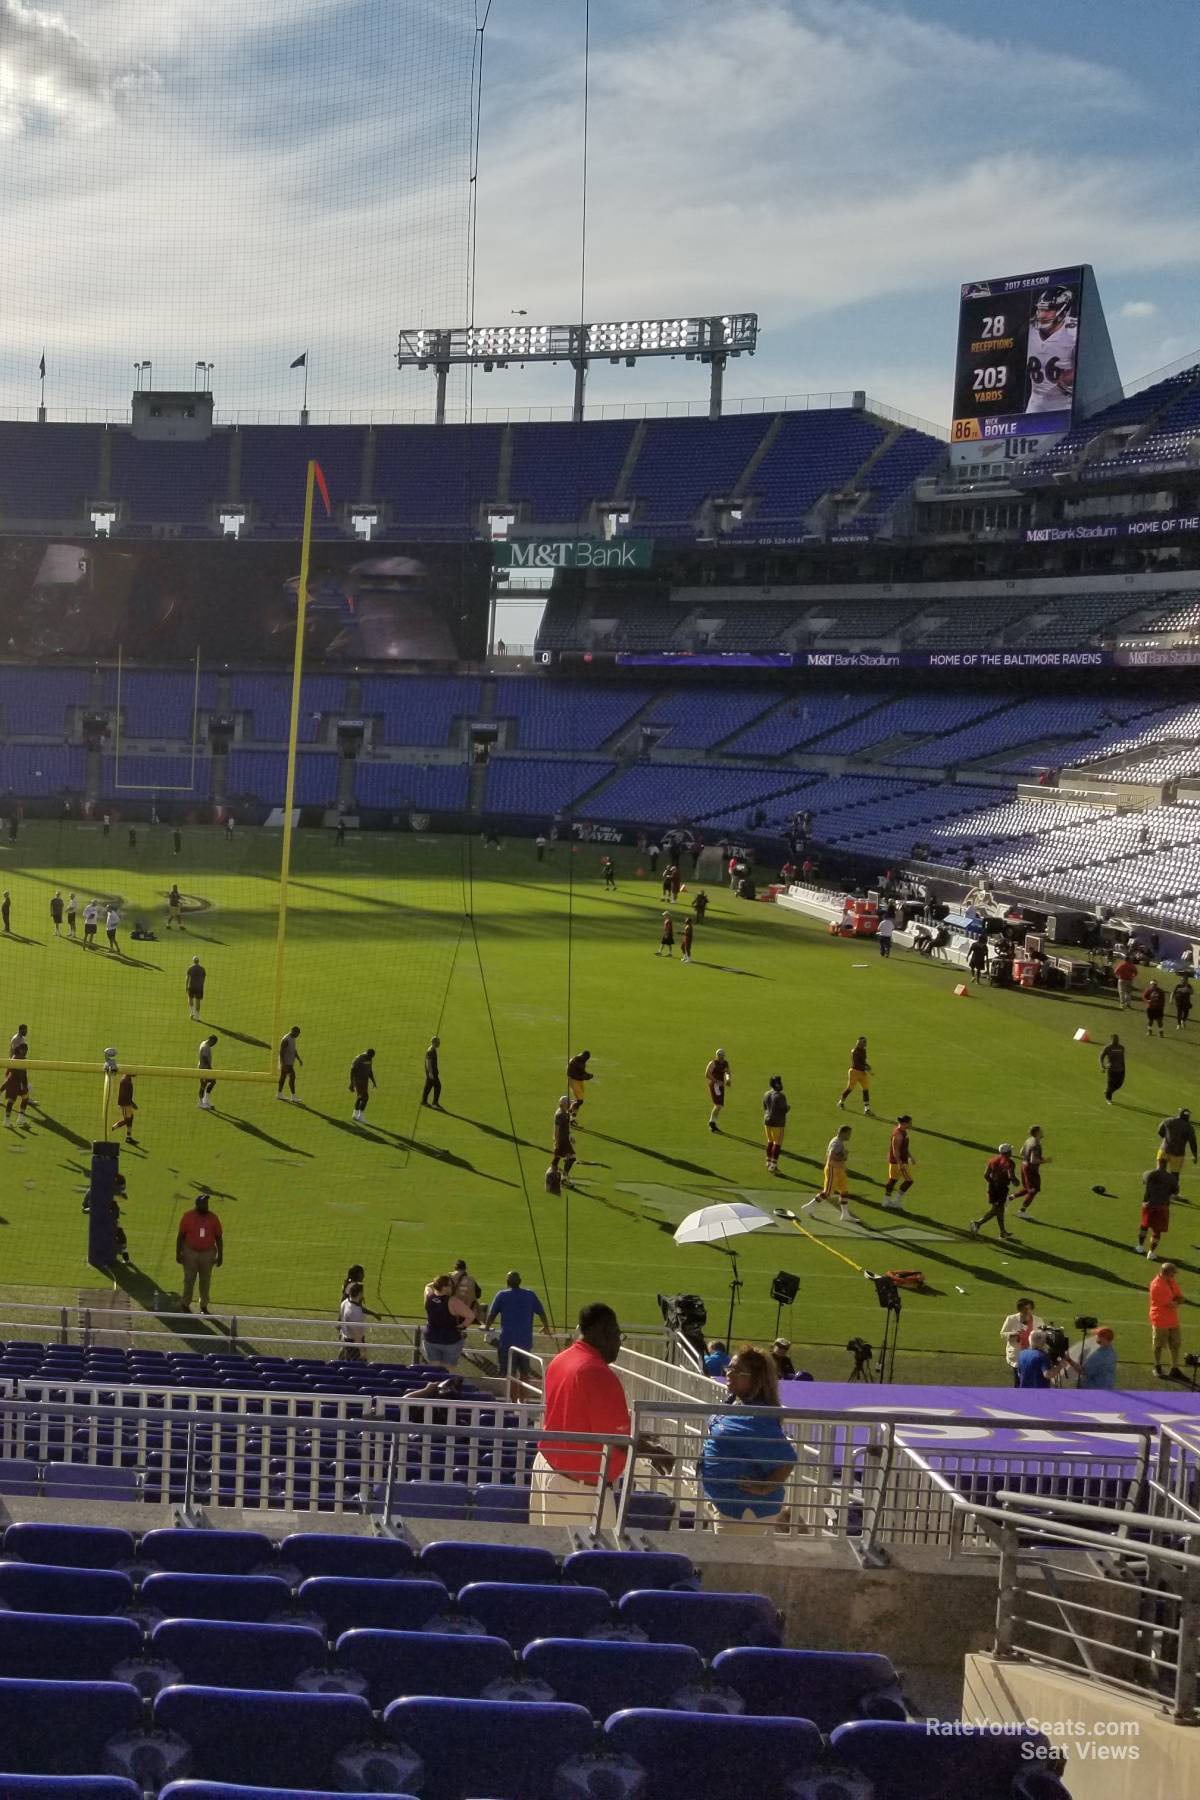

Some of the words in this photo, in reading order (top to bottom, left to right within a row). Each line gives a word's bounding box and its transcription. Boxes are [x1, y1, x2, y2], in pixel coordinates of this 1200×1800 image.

[1004, 280, 1021, 291] 2017
[1022, 275, 1050, 288] SEASON
[981, 315, 1005, 339] 28
[971, 338, 1015, 352] RECEPTIONS
[972, 366, 1007, 390] 203
[974, 390, 1003, 403] YARDS
[984, 417, 999, 425] NICK
[955, 422, 971, 439] 86
[984, 423, 1018, 437] BOYLE
[1004, 437, 1039, 460] Lite
[1026, 529, 1051, 542] M&T
[1051, 528, 1076, 541] Bank
[1076, 526, 1117, 539] Stadium
[1128, 521, 1159, 535] HOME
[1161, 520, 1176, 531] OF
[1178, 517, 1200, 529] THE
[510, 542, 573, 566] M&T
[575, 542, 636, 566] Bank
[807, 654, 834, 666] M&T
[834, 654, 858, 666] Bank
[859, 654, 900, 666] Stadium
[930, 654, 961, 666] HOME
[962, 654, 978, 666] OF
[980, 654, 1001, 665] THE
[1003, 653, 1060, 665] BALTIMORE
[1062, 653, 1102, 665] RAVENS
[1128, 651, 1151, 665] M&T
